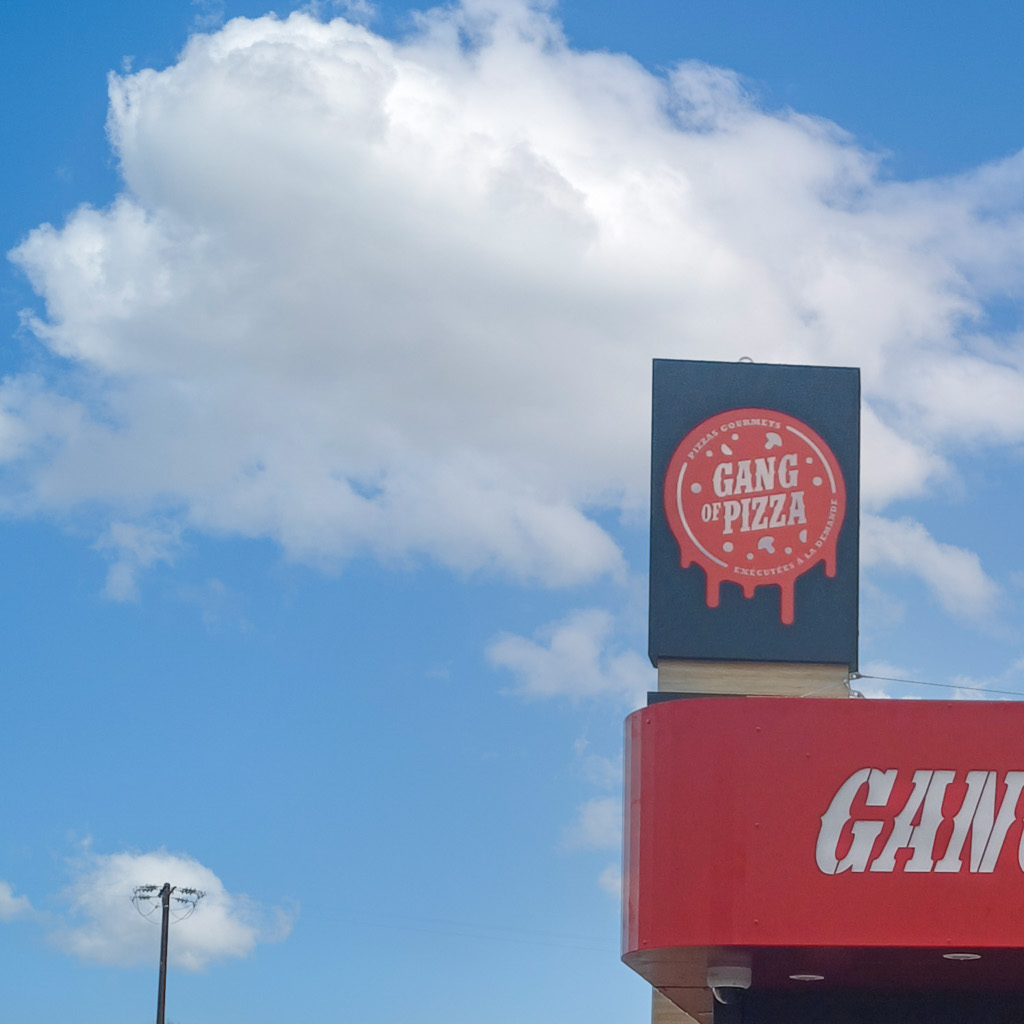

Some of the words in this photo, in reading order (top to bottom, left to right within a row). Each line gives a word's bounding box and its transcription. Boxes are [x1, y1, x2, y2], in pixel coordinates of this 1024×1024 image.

[688, 429, 719, 460] PIZZAS
[720, 418, 782, 432] GOURMETS
[712, 453, 799, 498] GANG
[701, 502, 722, 523] OF
[722, 491, 807, 535] PIZZA
[804, 548, 817, 560] LA
[815, 499, 838, 548] DEMANDE
